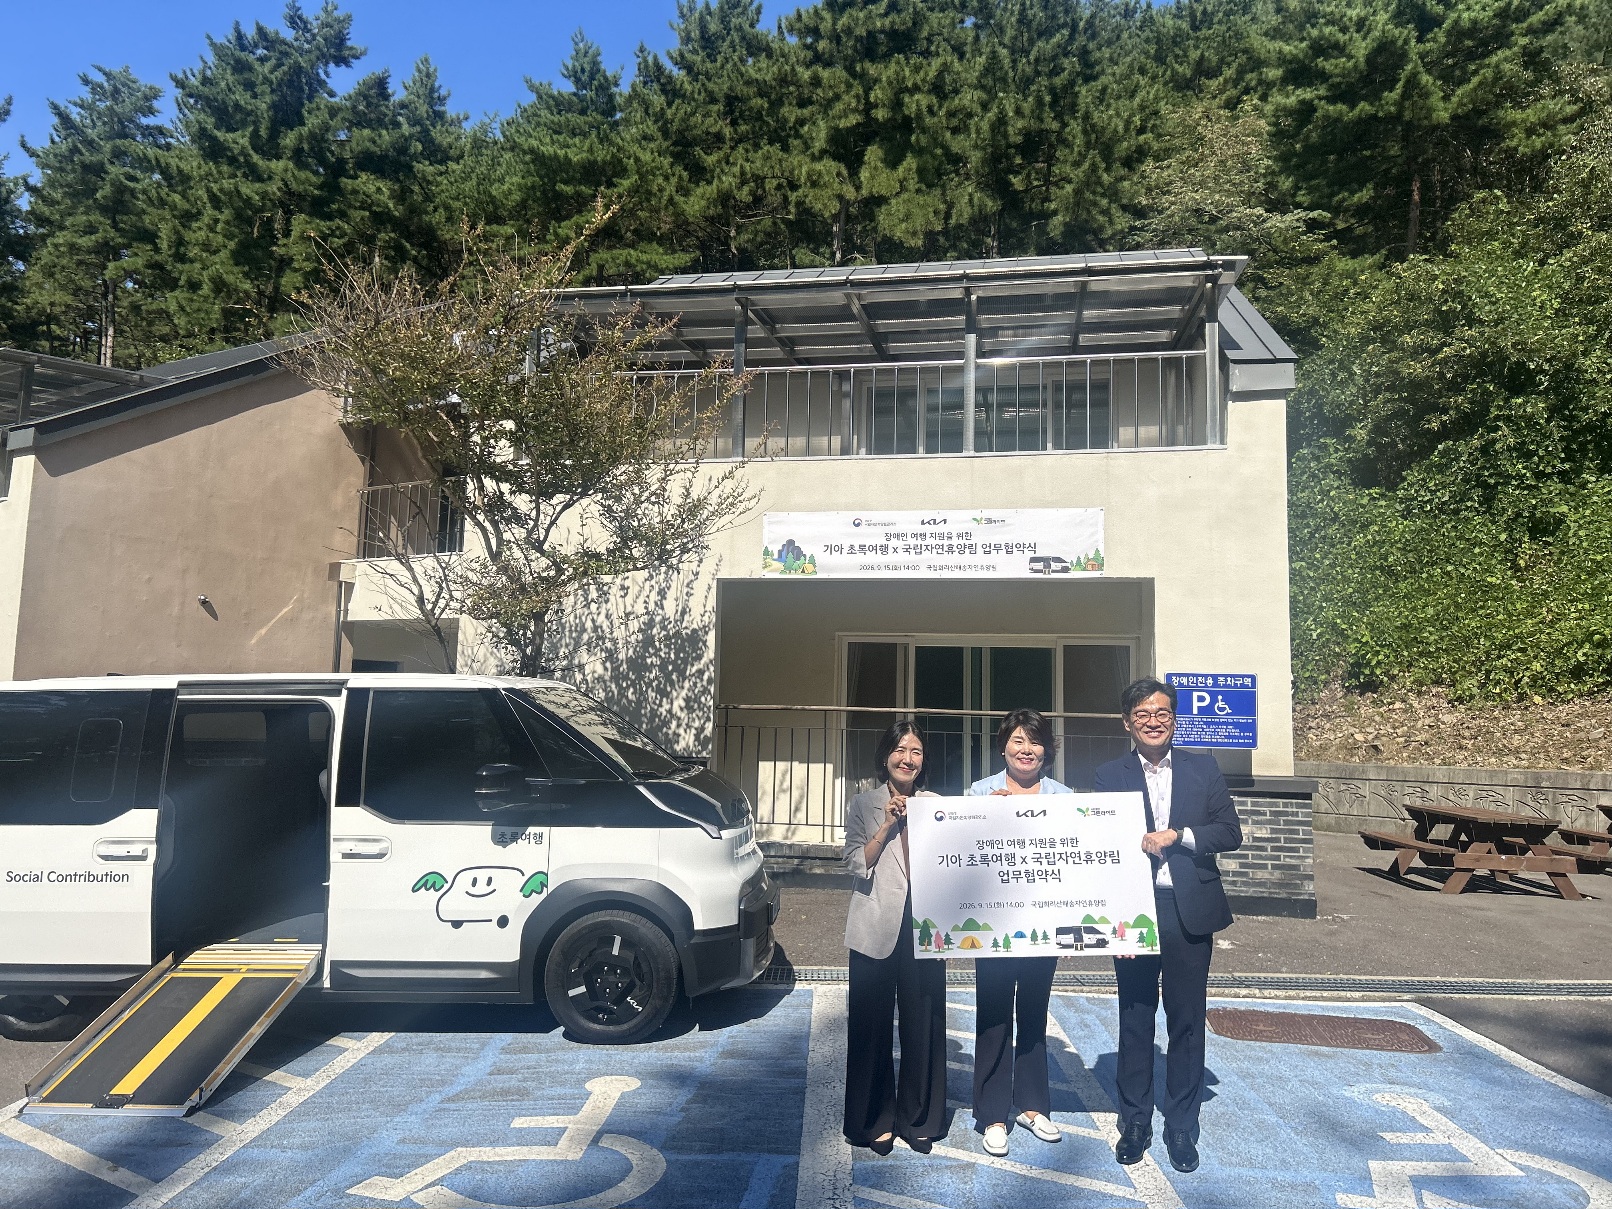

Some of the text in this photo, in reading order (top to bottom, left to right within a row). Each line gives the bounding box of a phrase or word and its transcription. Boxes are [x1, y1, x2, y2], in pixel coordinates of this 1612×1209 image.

[884, 531, 972, 541] 장애인 여행 지원을 위한
[823, 543, 844, 555] 기아
[846, 543, 889, 556] 초록여행
[901, 542, 978, 556] 국립자연휴양림
[981, 542, 1037, 555] 업무협약식
[1171, 676, 1252, 687] 장애인전용 주차구역
[1192, 691, 1211, 715] P
[497, 831, 544, 845] 초록여행
[975, 837, 1080, 851] 장애인 여행 지원을 위한
[938, 853, 963, 868] 기아
[965, 852, 1017, 868] 초록여행
[1031, 849, 1121, 866] 국립자연휴양림
[5, 870, 130, 883] Social Contribution
[997, 868, 1062, 884] 업무협약식
